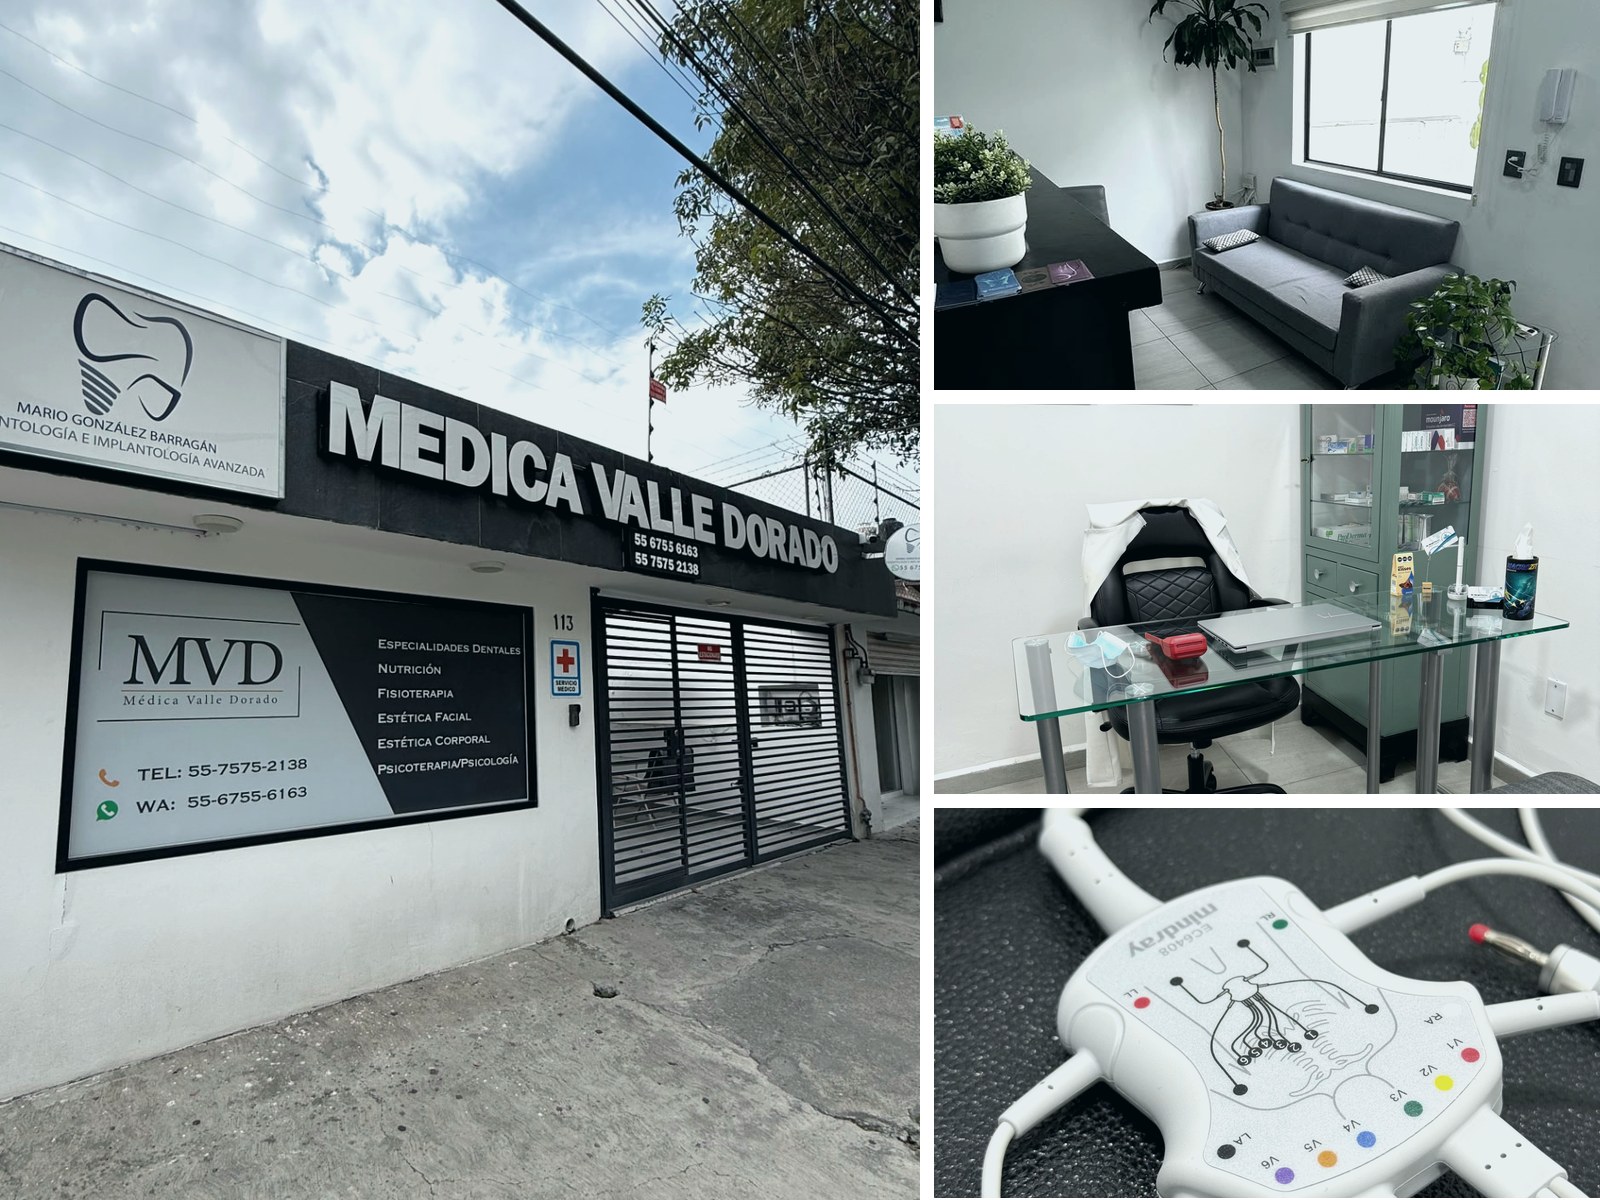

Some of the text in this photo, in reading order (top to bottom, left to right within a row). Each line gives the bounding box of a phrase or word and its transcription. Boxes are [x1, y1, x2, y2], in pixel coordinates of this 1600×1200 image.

[17, 401, 217, 453] MARIO GONZÁLEZ BARRAGÁN
[82, 432, 90, 444] E
[93, 434, 201, 466] IMPLANTOLOGÍA
[203, 457, 265, 478] AVANZADA
[329, 380, 839, 574] MEDICA VALLE DORADO
[634, 533, 698, 558] 55 6755 6163
[635, 552, 699, 575] 55 7575 2138
[553, 614, 574, 631] 113
[123, 634, 283, 686] MVD
[123, 694, 279, 706] Médica Valle Dorado
[138, 758, 308, 781] TEL: 55-7575-2138
[136, 786, 308, 814] WA: 55-6755-6163
[1260, 911, 1276, 921] RL
[1128, 903, 1218, 958] mindray
[1158, 923, 1213, 957] EC6408
[1123, 988, 1139, 998] LL
[1424, 1012, 1443, 1025] RA
[1446, 1038, 1464, 1050] V1
[1419, 1064, 1438, 1077] V2
[1389, 1089, 1408, 1102] V3
[1342, 1119, 1361, 1132] V4
[1233, 1132, 1252, 1145] LA
[1303, 1139, 1322, 1152] V5
[1260, 1156, 1280, 1169] V6
